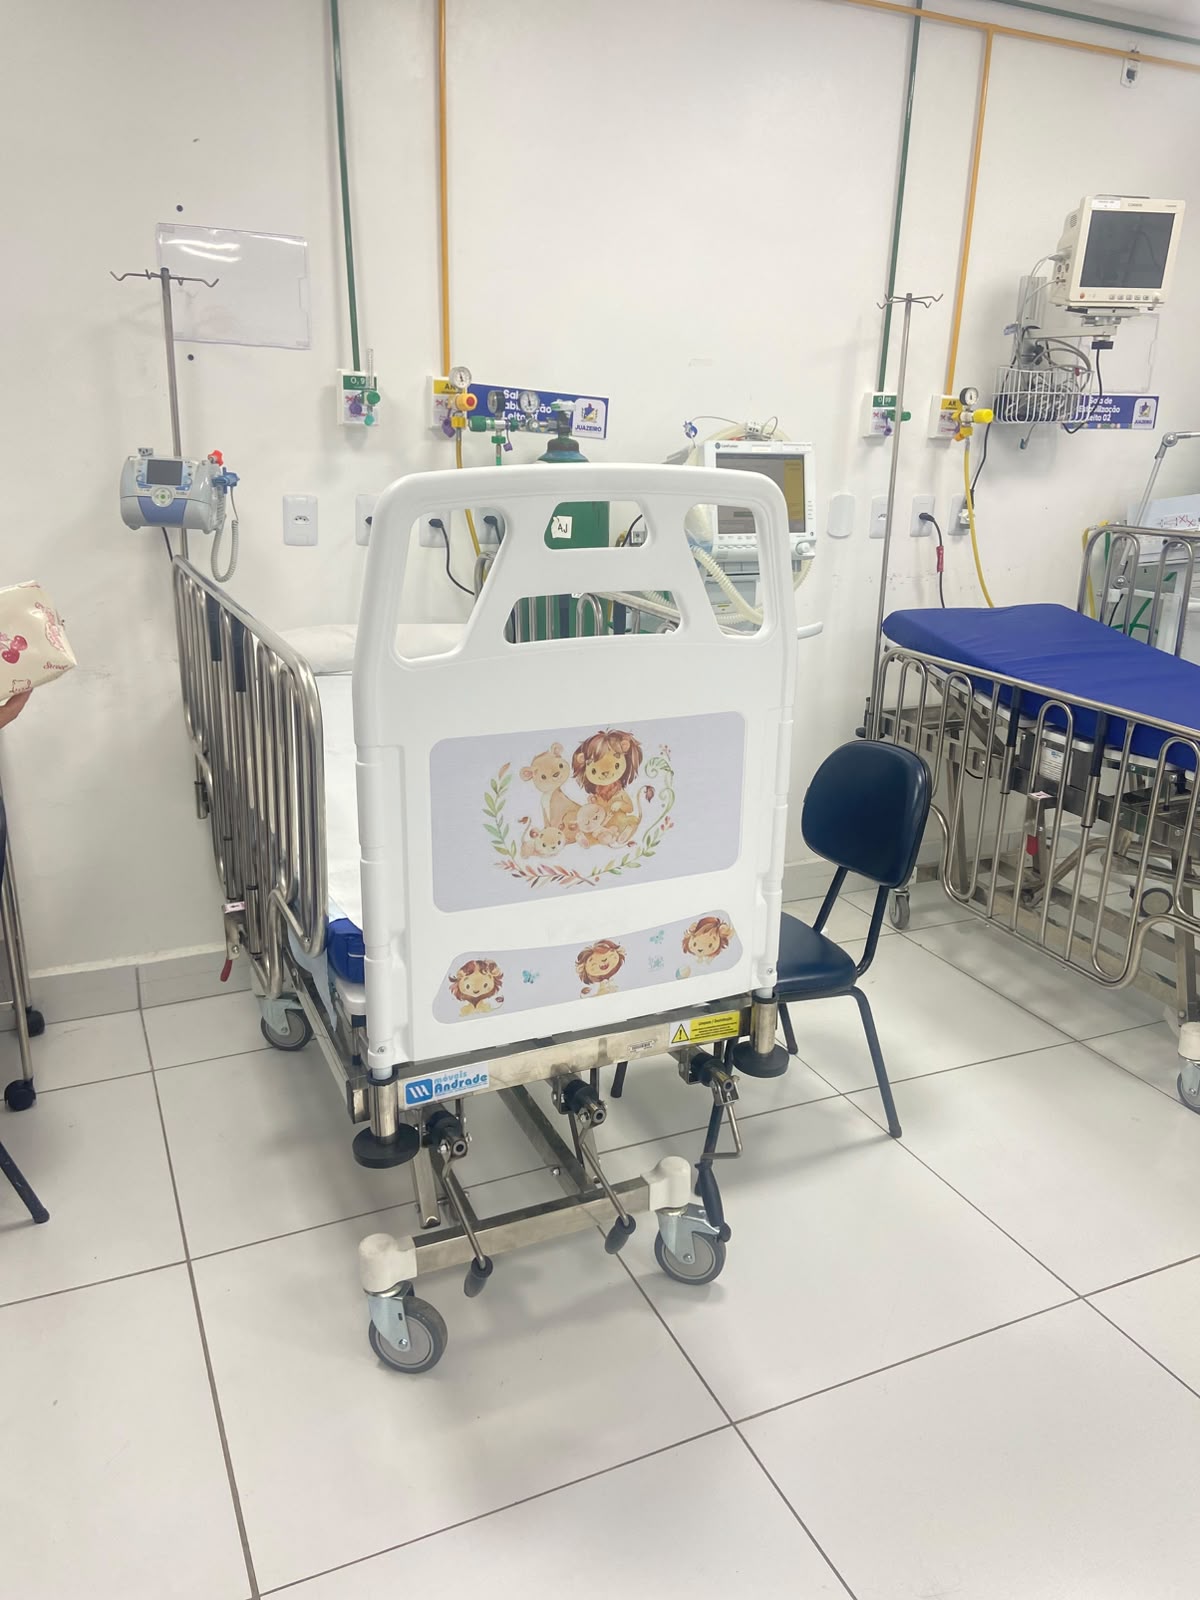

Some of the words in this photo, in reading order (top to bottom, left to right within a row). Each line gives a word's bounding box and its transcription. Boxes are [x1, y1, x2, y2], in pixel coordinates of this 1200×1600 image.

[1104, 396, 1114, 405] de
[575, 424, 602, 432] JUAZEIRO
[434, 1070, 467, 1085] móveis
[435, 1073, 488, 1095] Andrade
